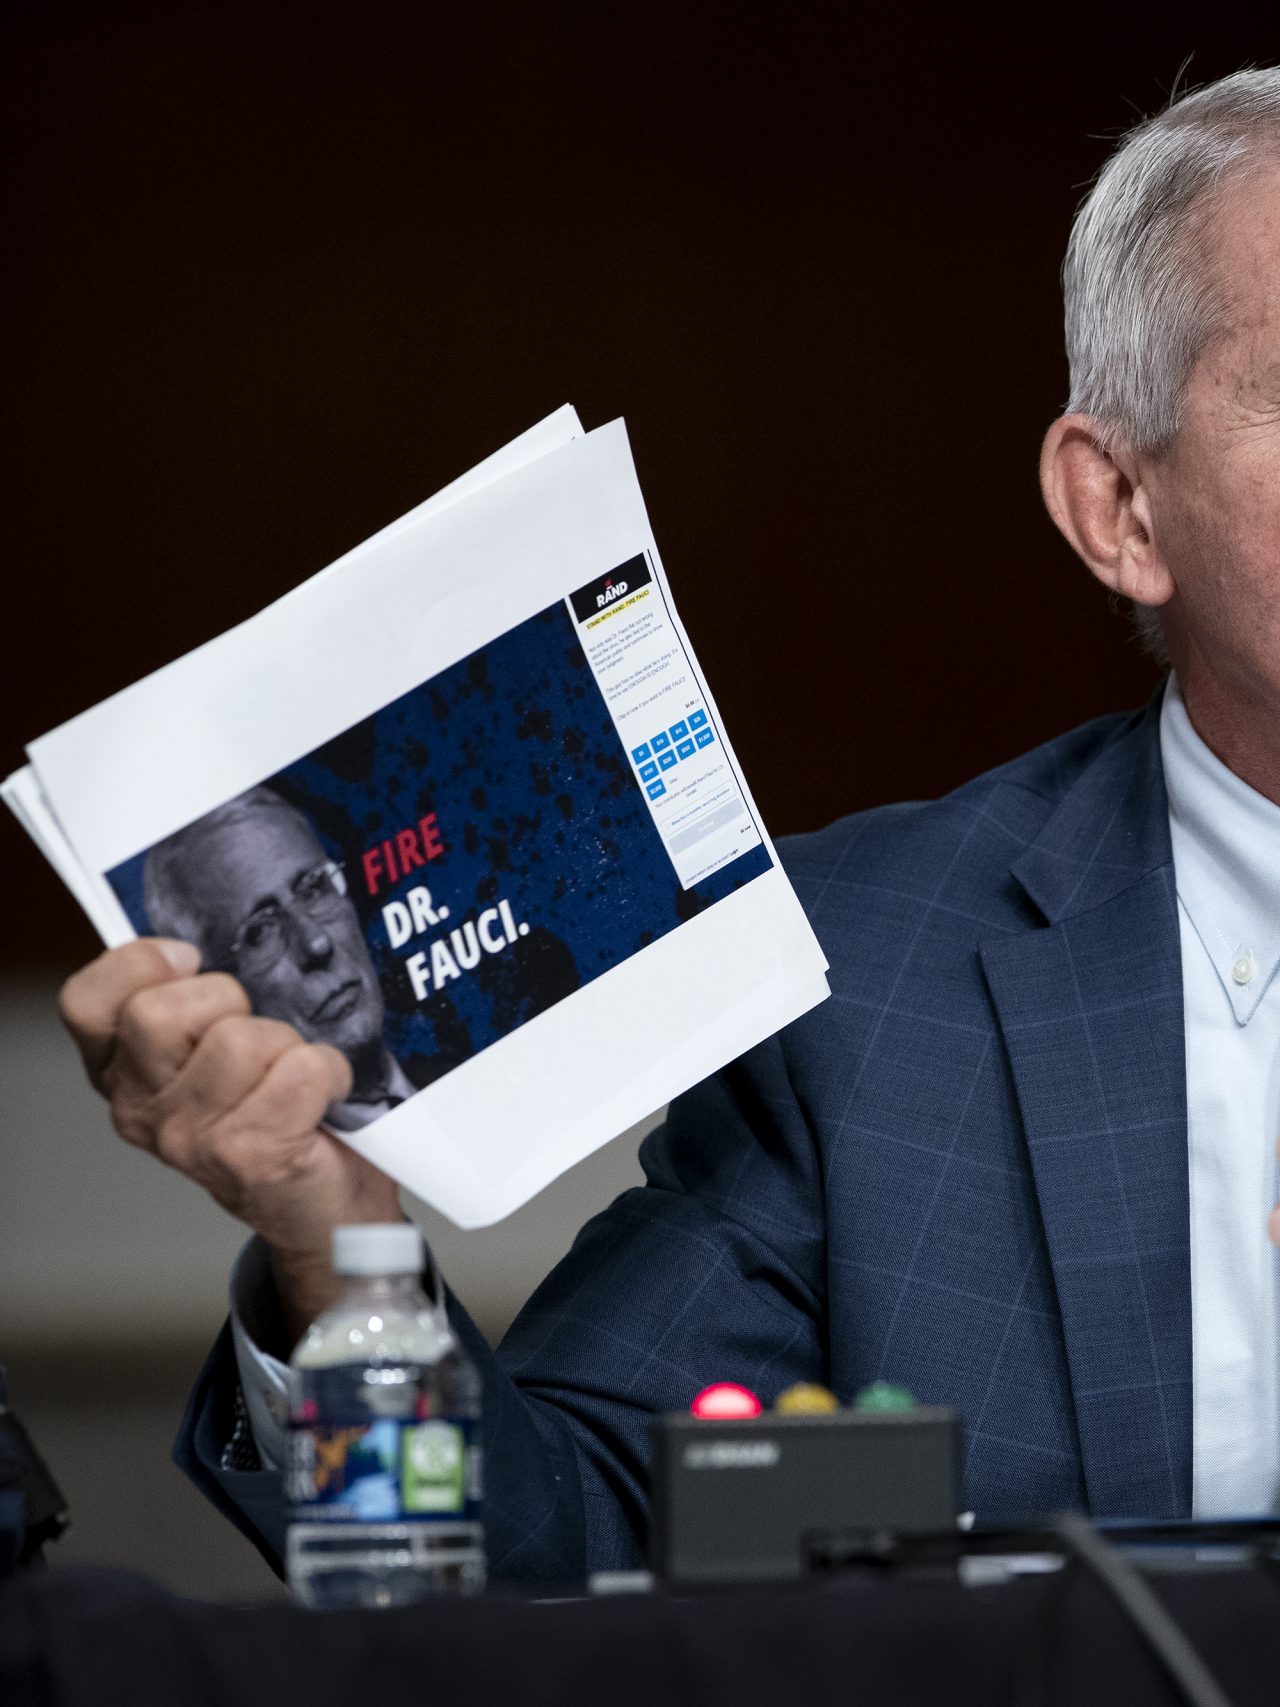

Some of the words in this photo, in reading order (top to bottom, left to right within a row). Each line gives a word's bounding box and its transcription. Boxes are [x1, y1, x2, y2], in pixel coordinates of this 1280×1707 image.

[596, 581, 628, 608] RAND
[362, 812, 444, 895] FIRE
[382, 886, 449, 950] DR.
[406, 899, 530, 1002] FAUCI.
